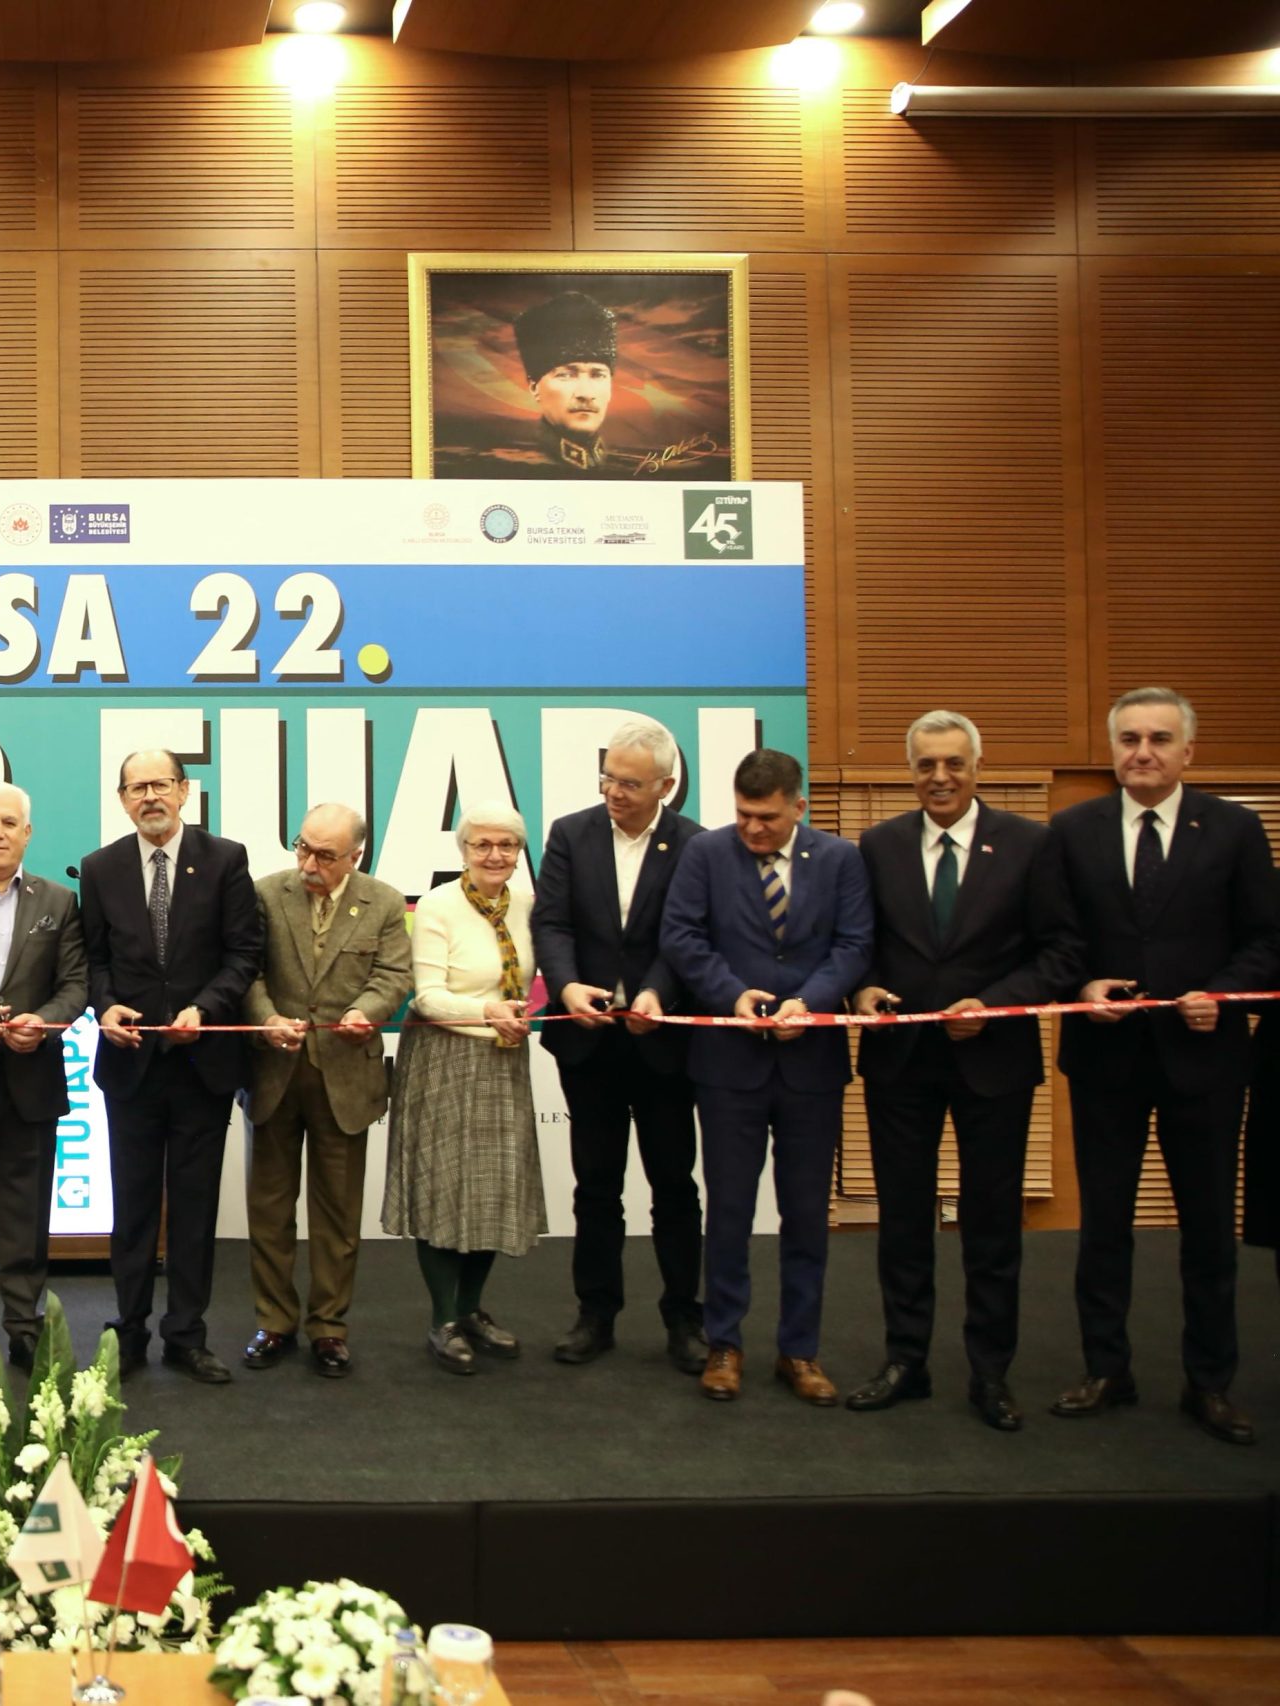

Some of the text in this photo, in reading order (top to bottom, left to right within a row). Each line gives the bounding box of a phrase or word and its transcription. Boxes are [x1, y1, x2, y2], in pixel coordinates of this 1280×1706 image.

[88, 513, 127, 521] BURSA
[527, 526, 585, 535] BURSA TEKNİK
[688, 503, 742, 553] 45
[527, 536, 586, 545] ÜNİVERSİTESİ
[185, 572, 392, 684] 22.
